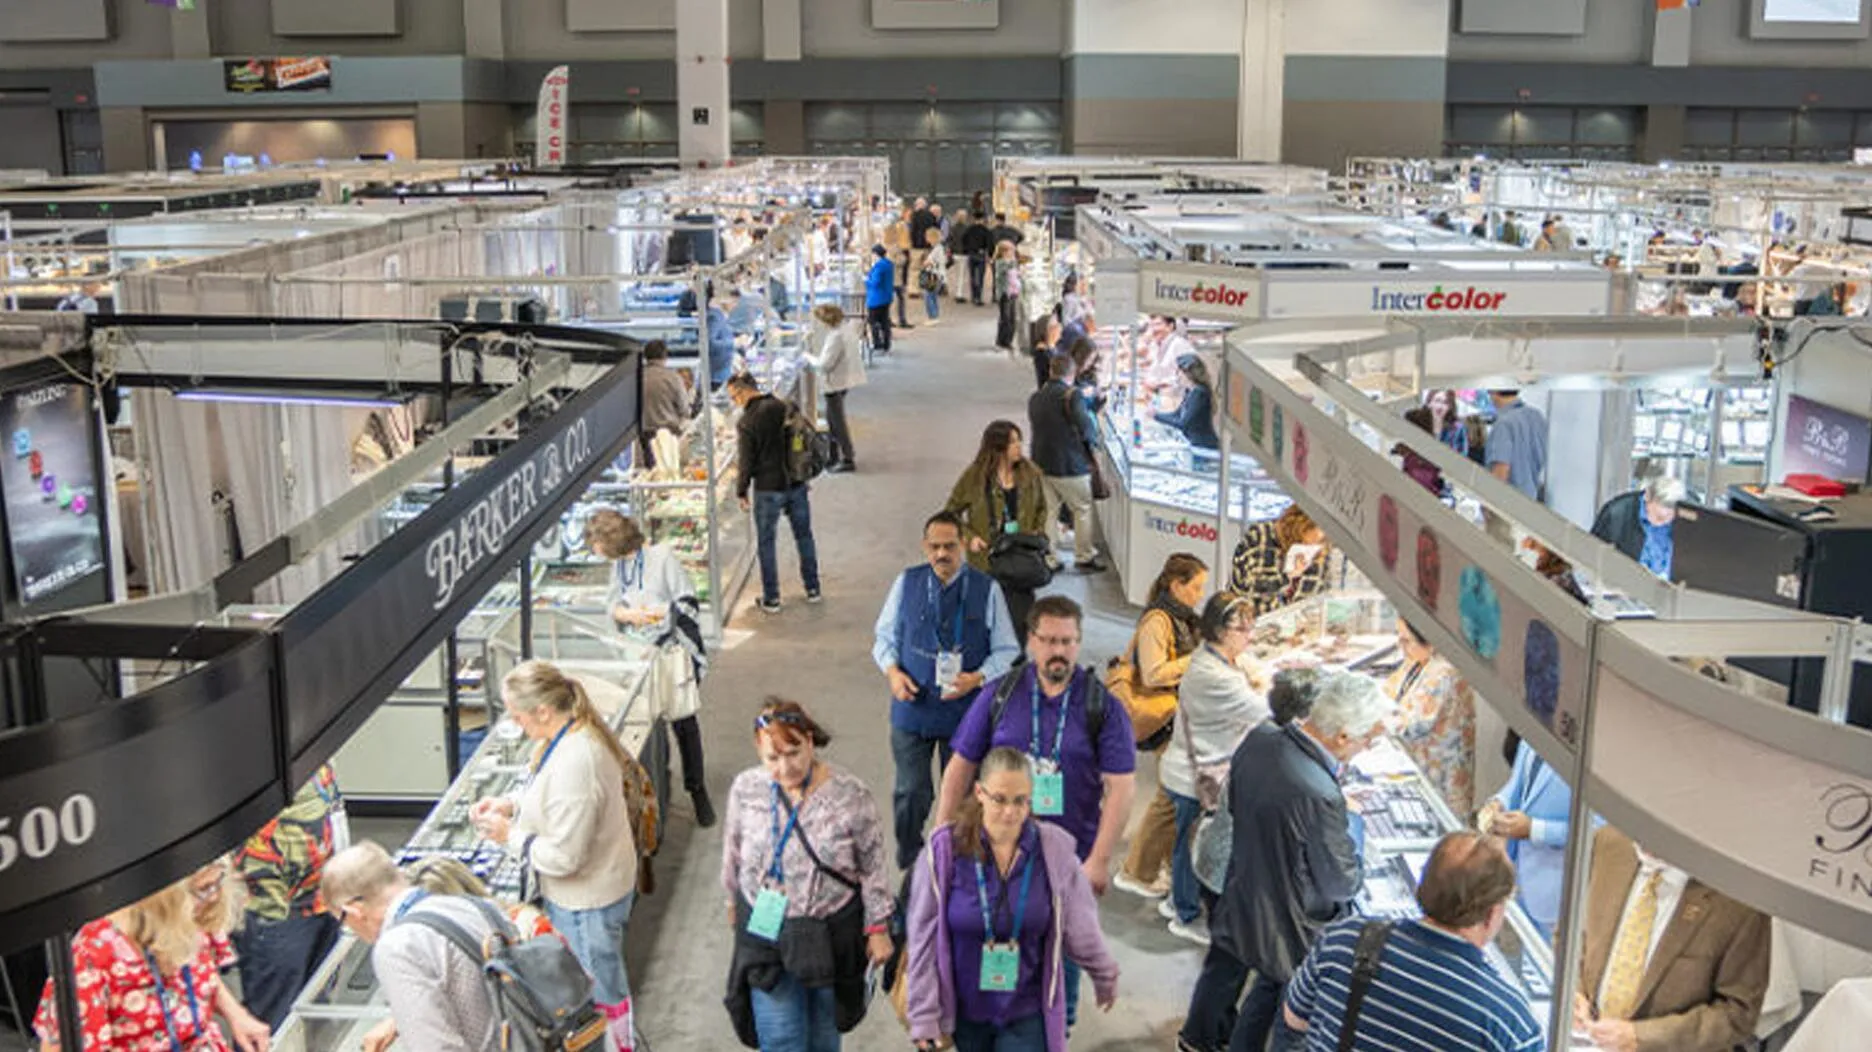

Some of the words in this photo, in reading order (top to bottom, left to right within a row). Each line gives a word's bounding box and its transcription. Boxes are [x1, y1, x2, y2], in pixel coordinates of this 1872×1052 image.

[1155, 278, 1248, 306] Intercolor
[1372, 285, 1507, 311] Intercolor
[425, 460, 538, 611] BARKER
[1144, 510, 1218, 542] Intercolo
